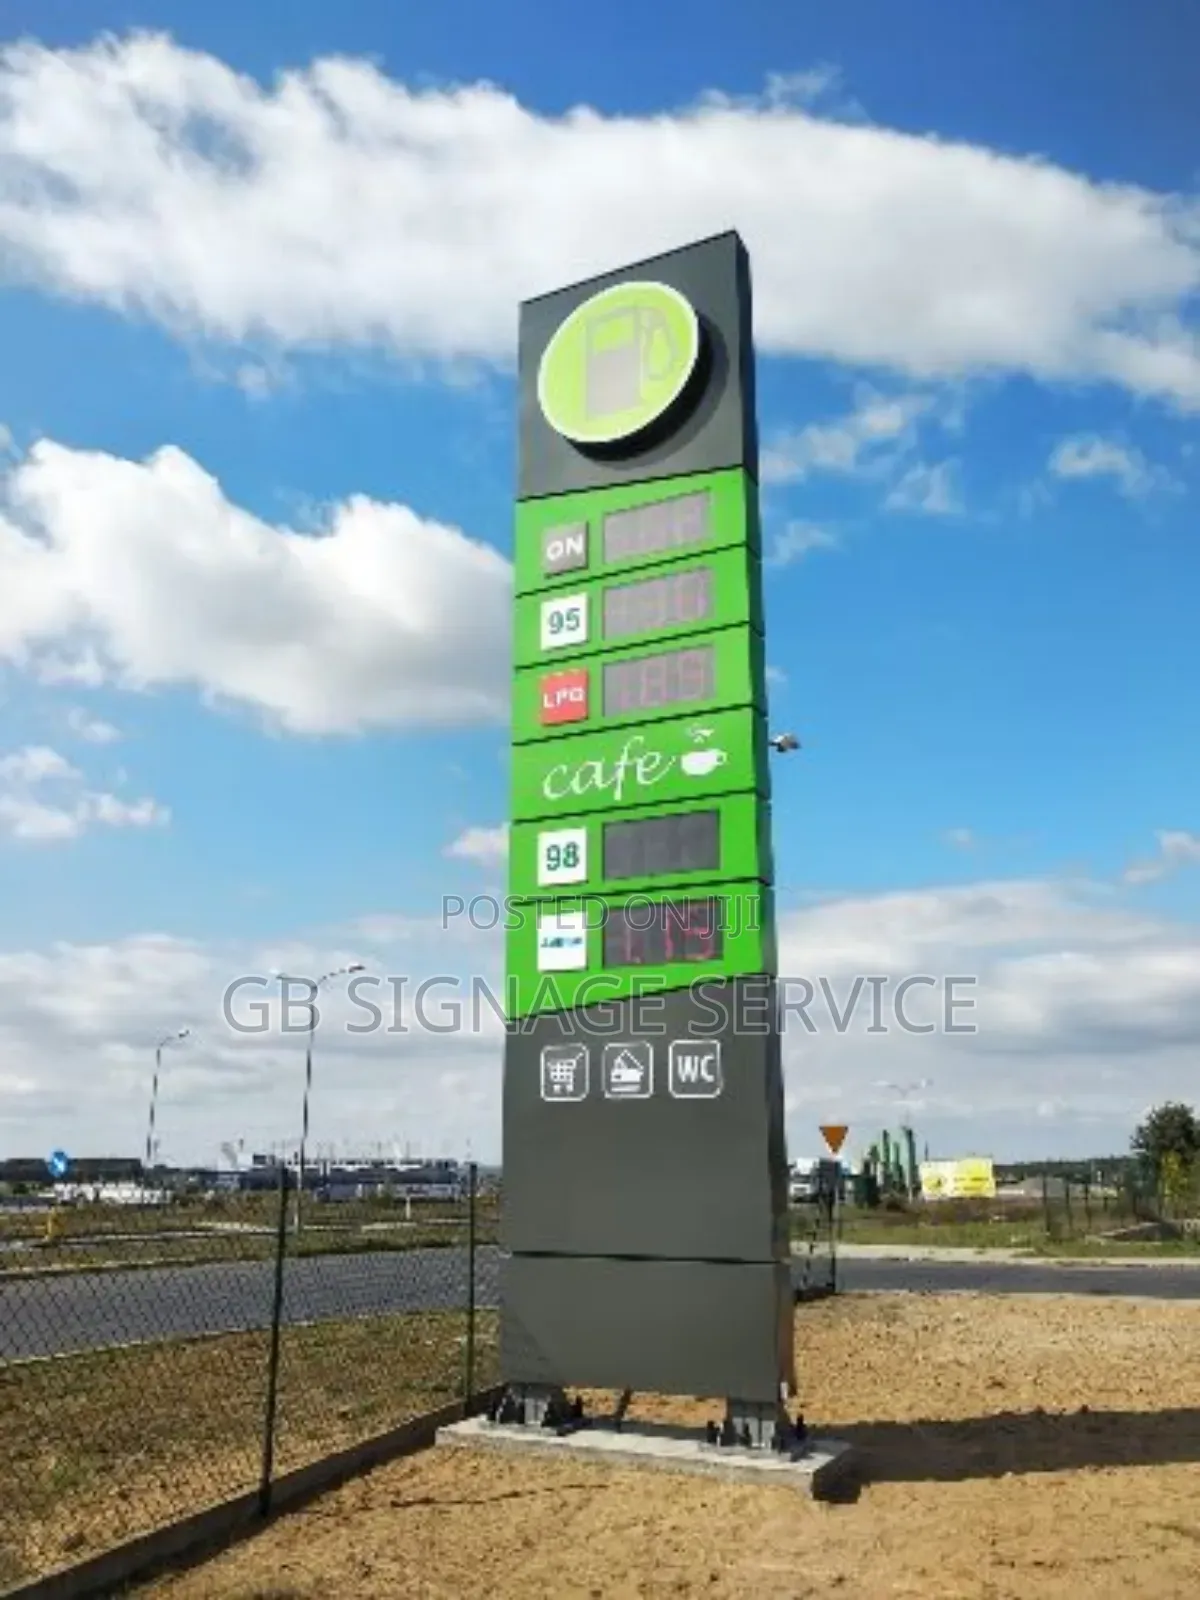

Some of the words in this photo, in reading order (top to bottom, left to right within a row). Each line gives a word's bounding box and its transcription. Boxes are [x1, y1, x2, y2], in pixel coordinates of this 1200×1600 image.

[546, 533, 585, 561] ON
[549, 607, 581, 635] 95
[542, 735, 676, 800] cafe
[546, 842, 580, 871] 98
[677, 1053, 715, 1083] WC
